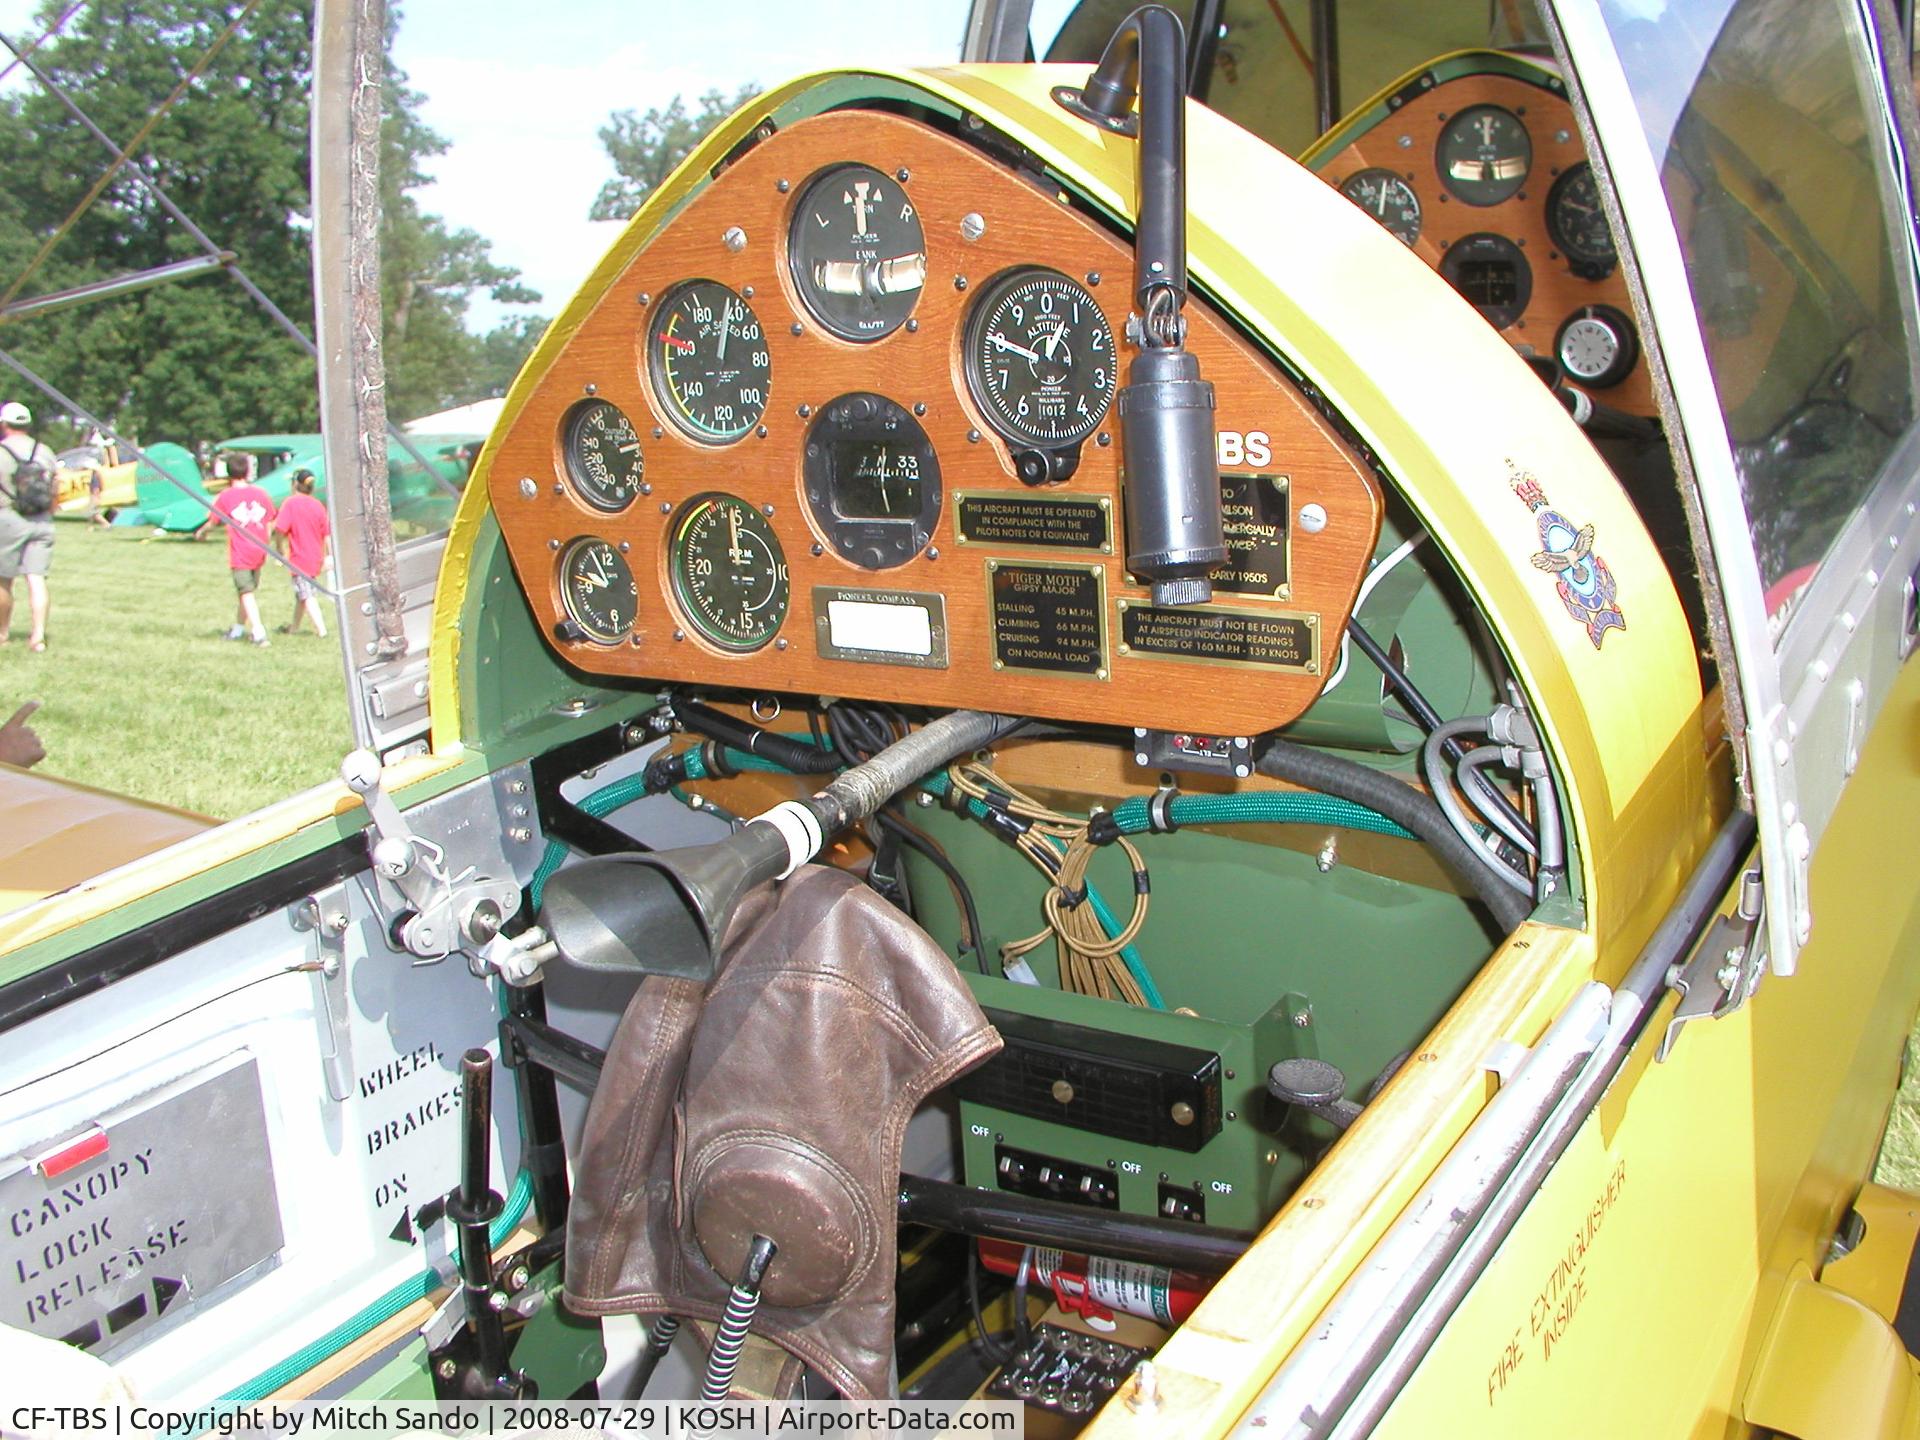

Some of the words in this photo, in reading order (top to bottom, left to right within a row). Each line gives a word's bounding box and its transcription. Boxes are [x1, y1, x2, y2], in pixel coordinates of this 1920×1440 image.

[852, 204, 874, 214] TRN
[900, 204, 913, 222] R
[816, 213, 830, 228] L
[1040, 292, 1053, 314] 0
[692, 307, 712, 324] 180
[1012, 304, 1024, 326] 9
[1074, 302, 1078, 324] 1
[699, 324, 712, 339] AIR
[742, 324, 758, 340] 60
[1026, 321, 1071, 340] ALTITUE
[996, 331, 1006, 352] 8
[1092, 329, 1104, 350] 2
[752, 352, 768, 367] 80
[998, 370, 1008, 390] 7
[1094, 368, 1106, 388] 3
[684, 382, 704, 397] 140
[740, 388, 760, 404] 100
[714, 406, 732, 420] 120
[1018, 394, 1030, 416] 6
[1076, 394, 1088, 416] 4
[898, 456, 918, 468] 33
[626, 474, 638, 486] 50
[735, 509, 743, 526] 5
[966, 504, 982, 513] THIS
[984, 504, 1020, 515] AIRCRAFT
[1022, 506, 1043, 516] MUST
[1044, 507, 1054, 516] BE
[1056, 508, 1097, 518] OPERATED
[982, 516, 991, 524] IN
[992, 516, 1044, 528] COMPLIANCE
[1046, 519, 1066, 529] WITH
[1067, 520, 1081, 529] THE
[1002, 528, 1026, 537] NOTES
[1029, 529, 1041, 538] OR
[1043, 530, 1089, 541] EQUIVALENT
[602, 553, 613, 566] 12
[696, 558, 712, 575] 20
[585, 582, 593, 593] 9
[630, 582, 637, 595] 3
[1014, 584, 1040, 592] GIPSY
[1042, 586, 1076, 595] MAJOR
[610, 609, 619, 622] 6
[997, 603, 1035, 613] STALLING
[1055, 607, 1067, 615] 45
[740, 612, 754, 629] 15
[998, 618, 1040, 629] CLIMBING
[1056, 623, 1068, 631] 66
[1137, 613, 1153, 622] THE
[1154, 616, 1198, 627] AIRCRAFT
[1200, 619, 1223, 629] MUST
[1226, 621, 1245, 631] NOT
[1248, 623, 1259, 632] BE
[1261, 624, 1295, 634] FLOWN
[999, 633, 1040, 643] CRUISING
[1056, 638, 1068, 646] 94
[1138, 625, 1150, 634] AT
[1247, 635, 1294, 647] READINGS
[1007, 648, 1022, 657] ON
[1024, 650, 1062, 660] NORMAL
[1065, 653, 1090, 663] LOAD
[1134, 637, 1144, 645] IN
[1146, 638, 1178, 648] EXCESS
[1180, 640, 1192, 649] OF
[1197, 642, 1213, 652] 160
[1250, 647, 1266, 657] 139
[1269, 649, 1299, 660] KNOTS
[360, 1041, 444, 1098] WHEEL
[367, 1084, 464, 1155] BRAKES
[971, 1124, 990, 1138] OFF
[1122, 1161, 1142, 1174] OFF
[10, 1148, 153, 1238] CANOPY
[374, 1174, 408, 1208] ON
[1212, 1181, 1232, 1194] OFF
[15, 1216, 113, 1283] LOCK
[26, 1220, 189, 1323] RELEASE
[1488, 1327, 1524, 1407] FIRE
[1530, 1160, 1626, 1338] EXTINGUISHER
[1544, 1266, 1588, 1362] INSIDE
